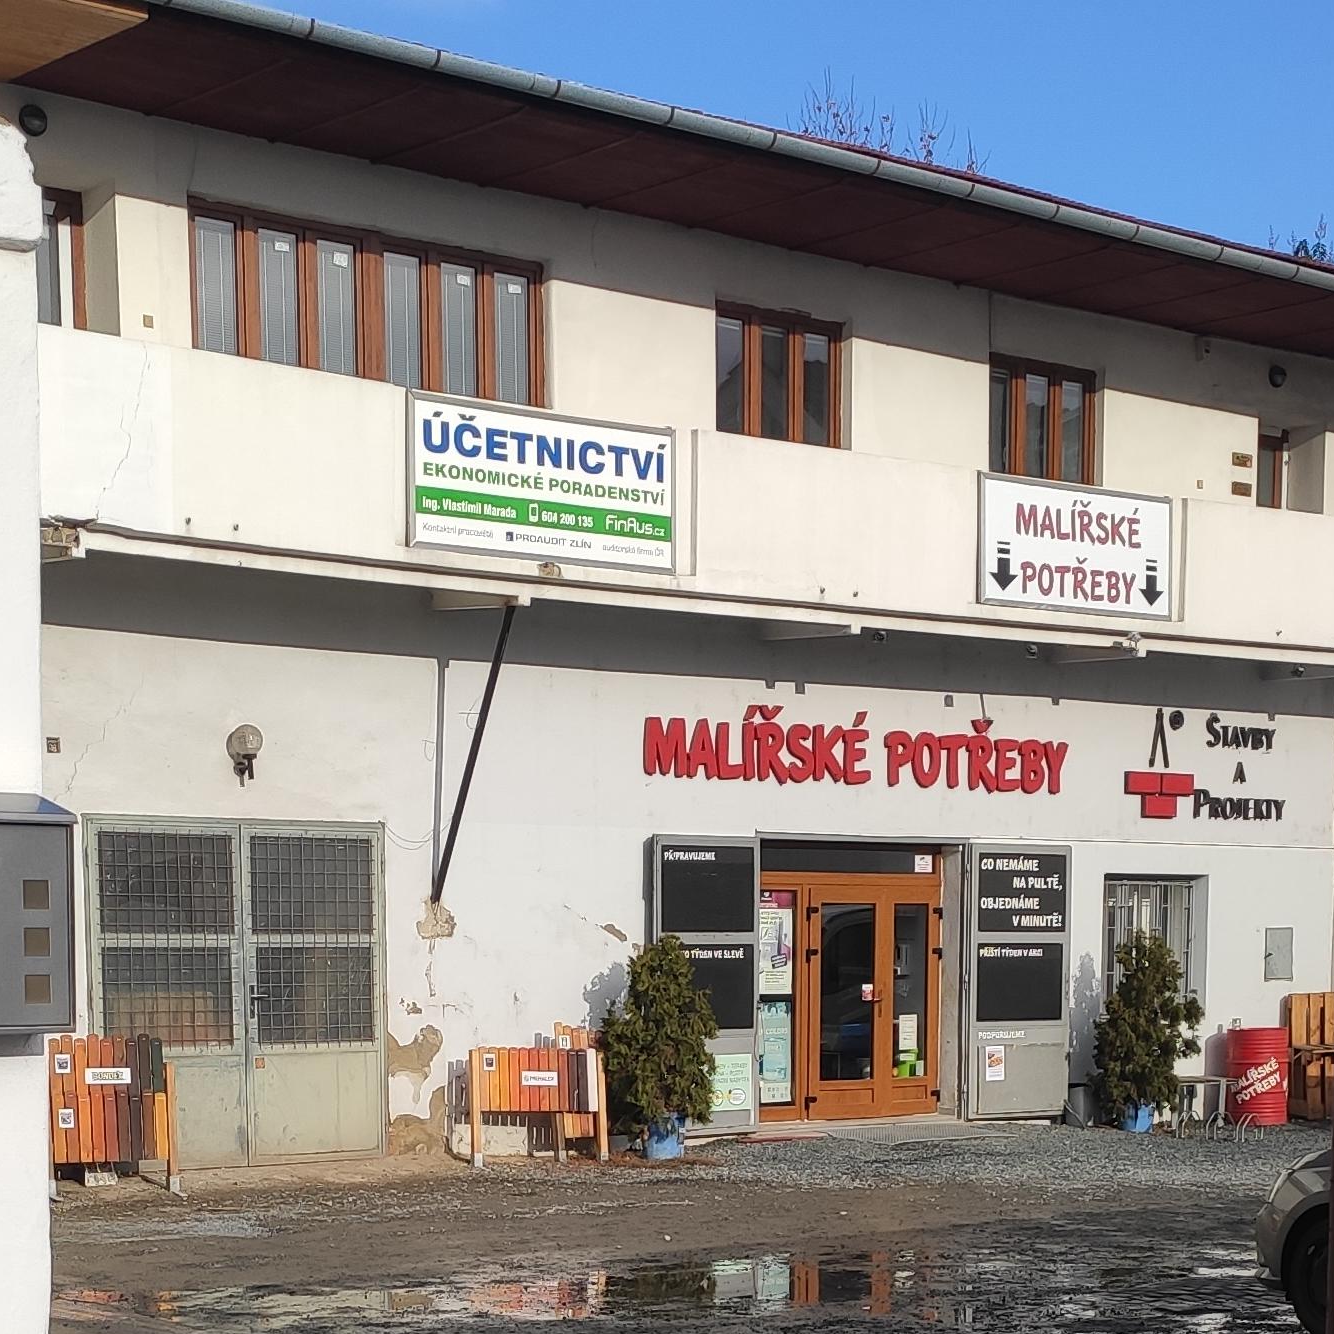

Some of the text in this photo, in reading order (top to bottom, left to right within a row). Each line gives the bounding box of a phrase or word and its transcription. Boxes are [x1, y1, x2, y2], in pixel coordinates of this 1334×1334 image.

[422, 411, 667, 484] ÚČETNICTVÍ
[423, 461, 665, 506] EKONOMICKÉ PORADENSTVÍ
[422, 496, 517, 519] Ing. Vlastimil Marada
[541, 510, 594, 528] 604 200 135
[1015, 499, 1142, 549] MALÍŘSKÉ
[515, 533, 592, 551] PROAUDIT ZLÍN
[1020, 556, 1137, 605] POTŘEBY
[643, 704, 1070, 796] MALÍŘSKÉ POTŘEBY
[980, 856, 1040, 871] CO NEMÁME
[1012, 873, 1063, 891] NA PULTĚ,
[980, 894, 1040, 909] OBJEDNÁME
[1012, 914, 1020, 927] V
